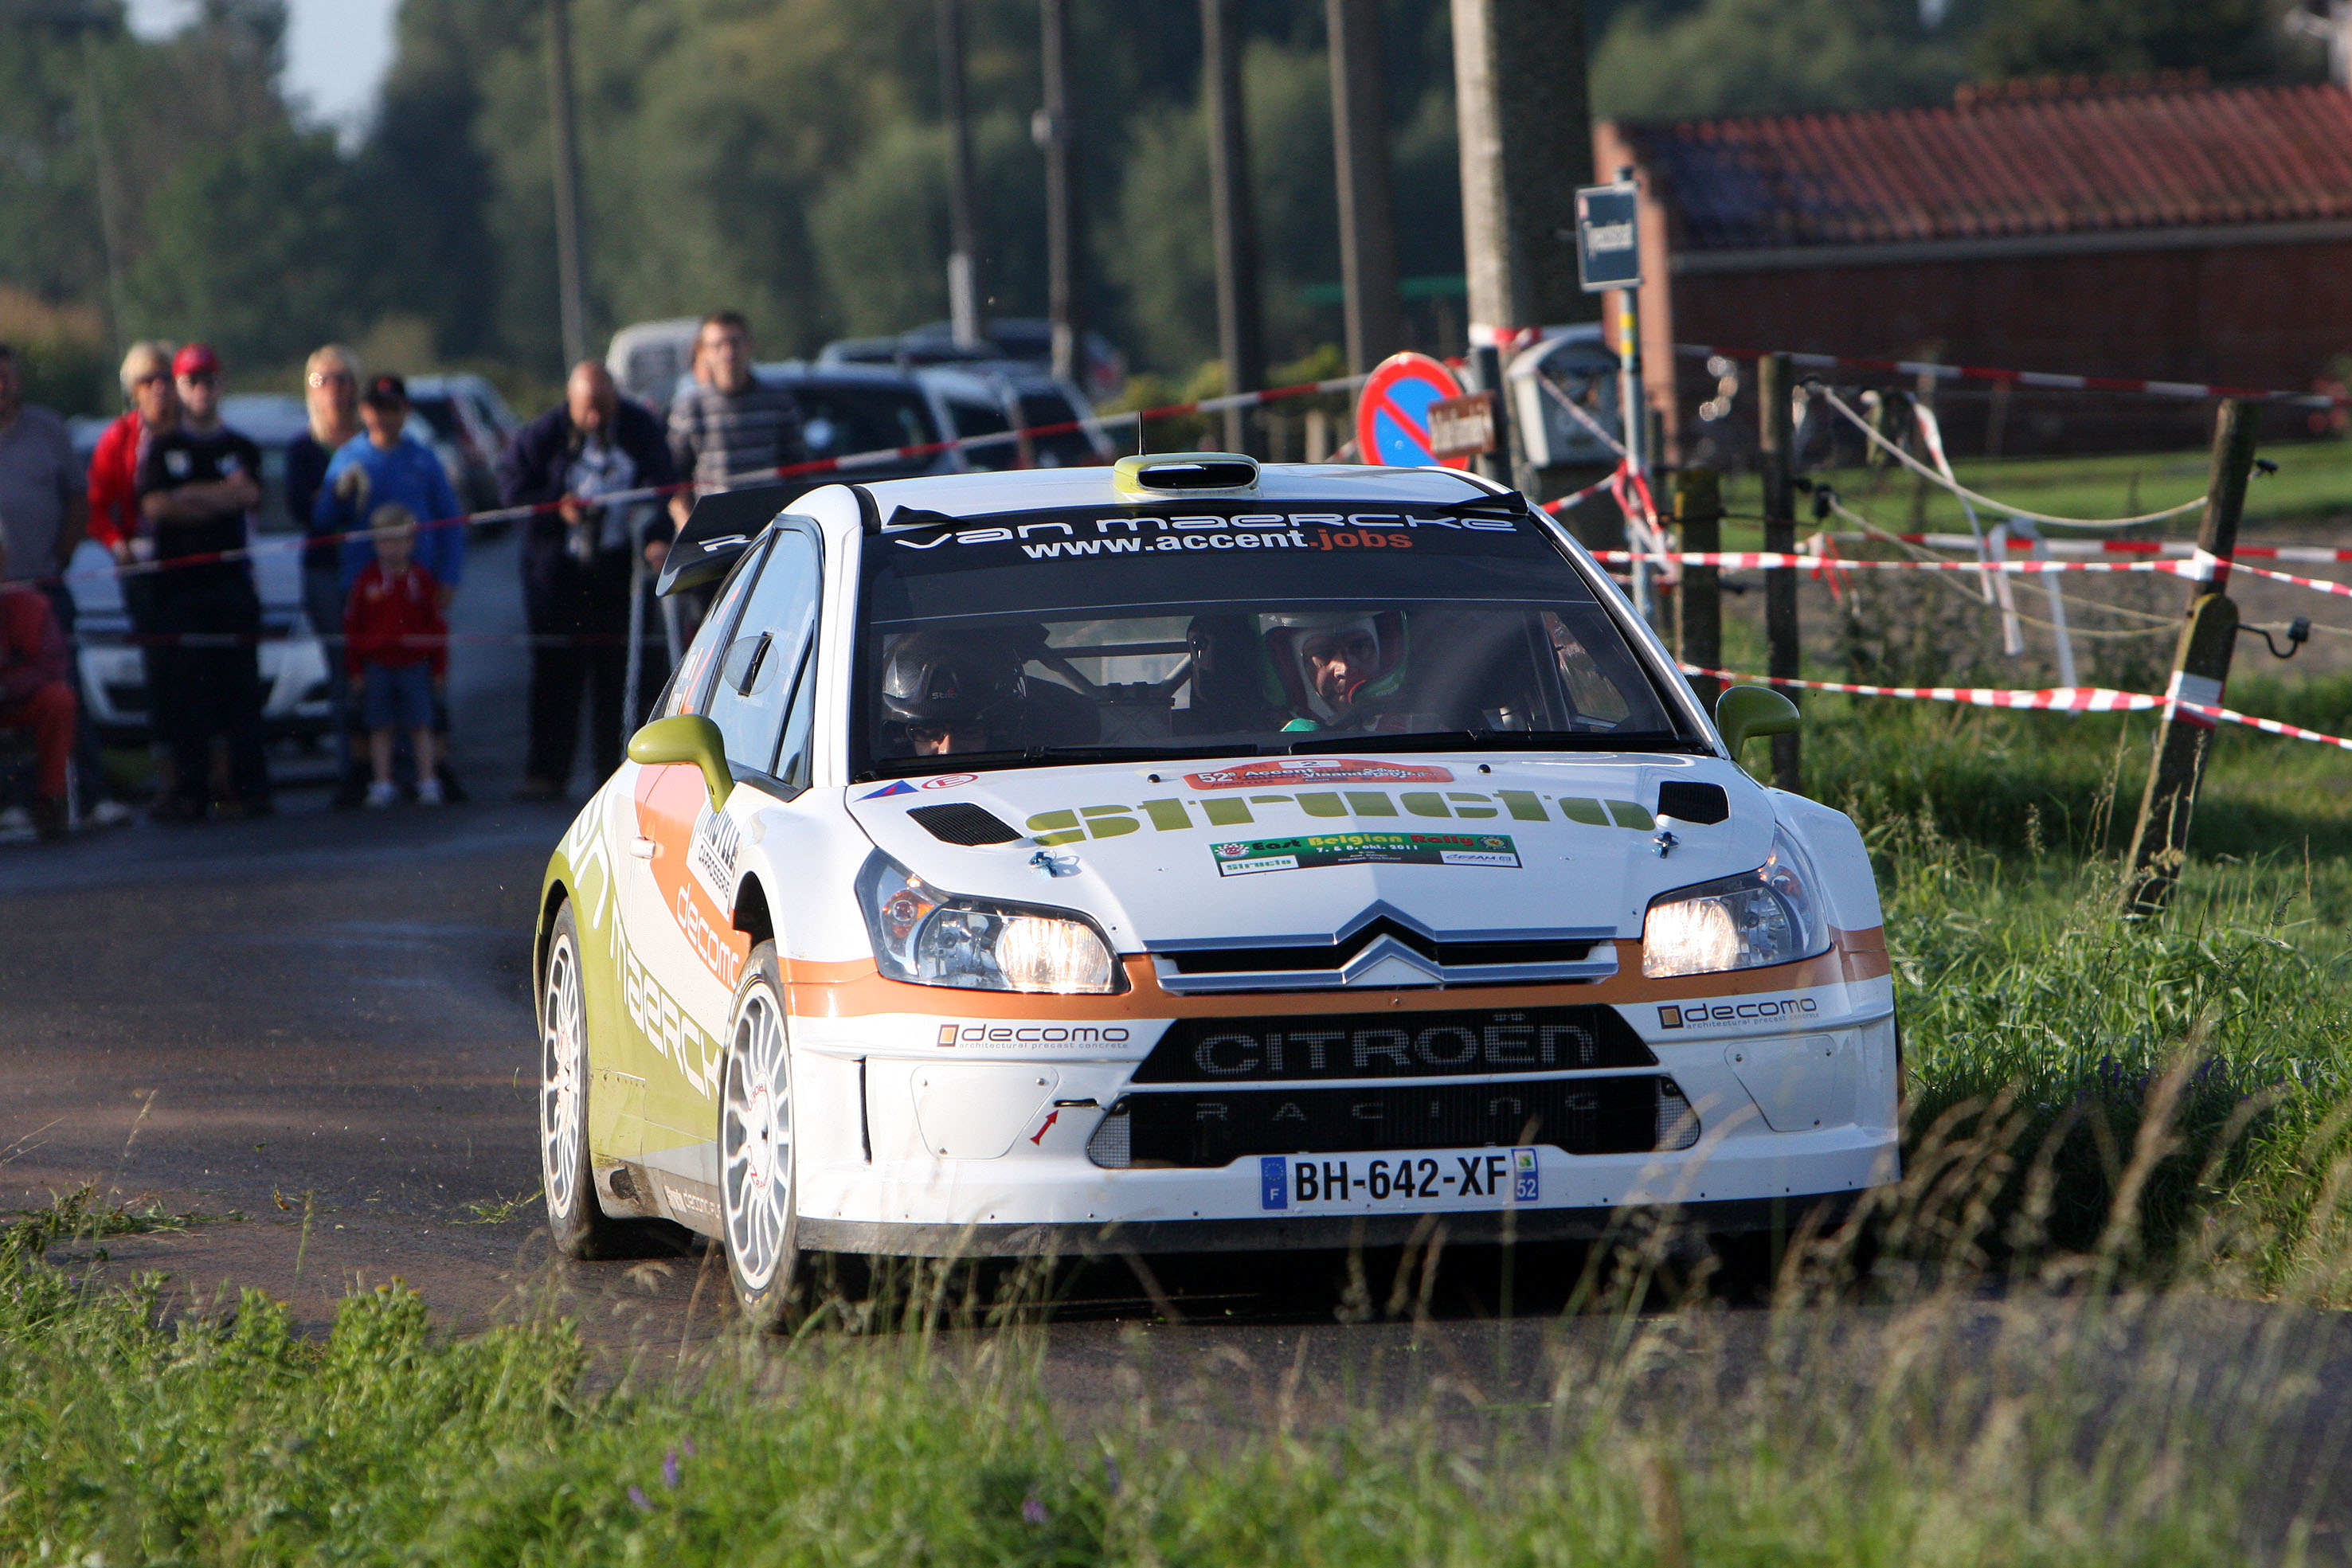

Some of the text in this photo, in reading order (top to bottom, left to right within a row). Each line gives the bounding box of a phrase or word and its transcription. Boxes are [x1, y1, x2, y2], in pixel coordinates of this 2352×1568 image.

[894, 522, 1074, 549] van
[1021, 529, 1414, 558] www.accent.jobs
[1245, 768, 1315, 777] Accent
[1252, 839, 1301, 851] East
[1308, 833, 1403, 846] Belgian
[1410, 835, 1474, 847] Rally
[1685, 997, 1818, 1023] decomo
[1686, 1019, 1751, 1030] architectural
[1754, 1015, 1787, 1026] precast
[961, 1023, 1129, 1042] decomo
[1031, 1042, 1074, 1050] precast
[1270, 1155, 1536, 1202] F BH-642-XF 52
